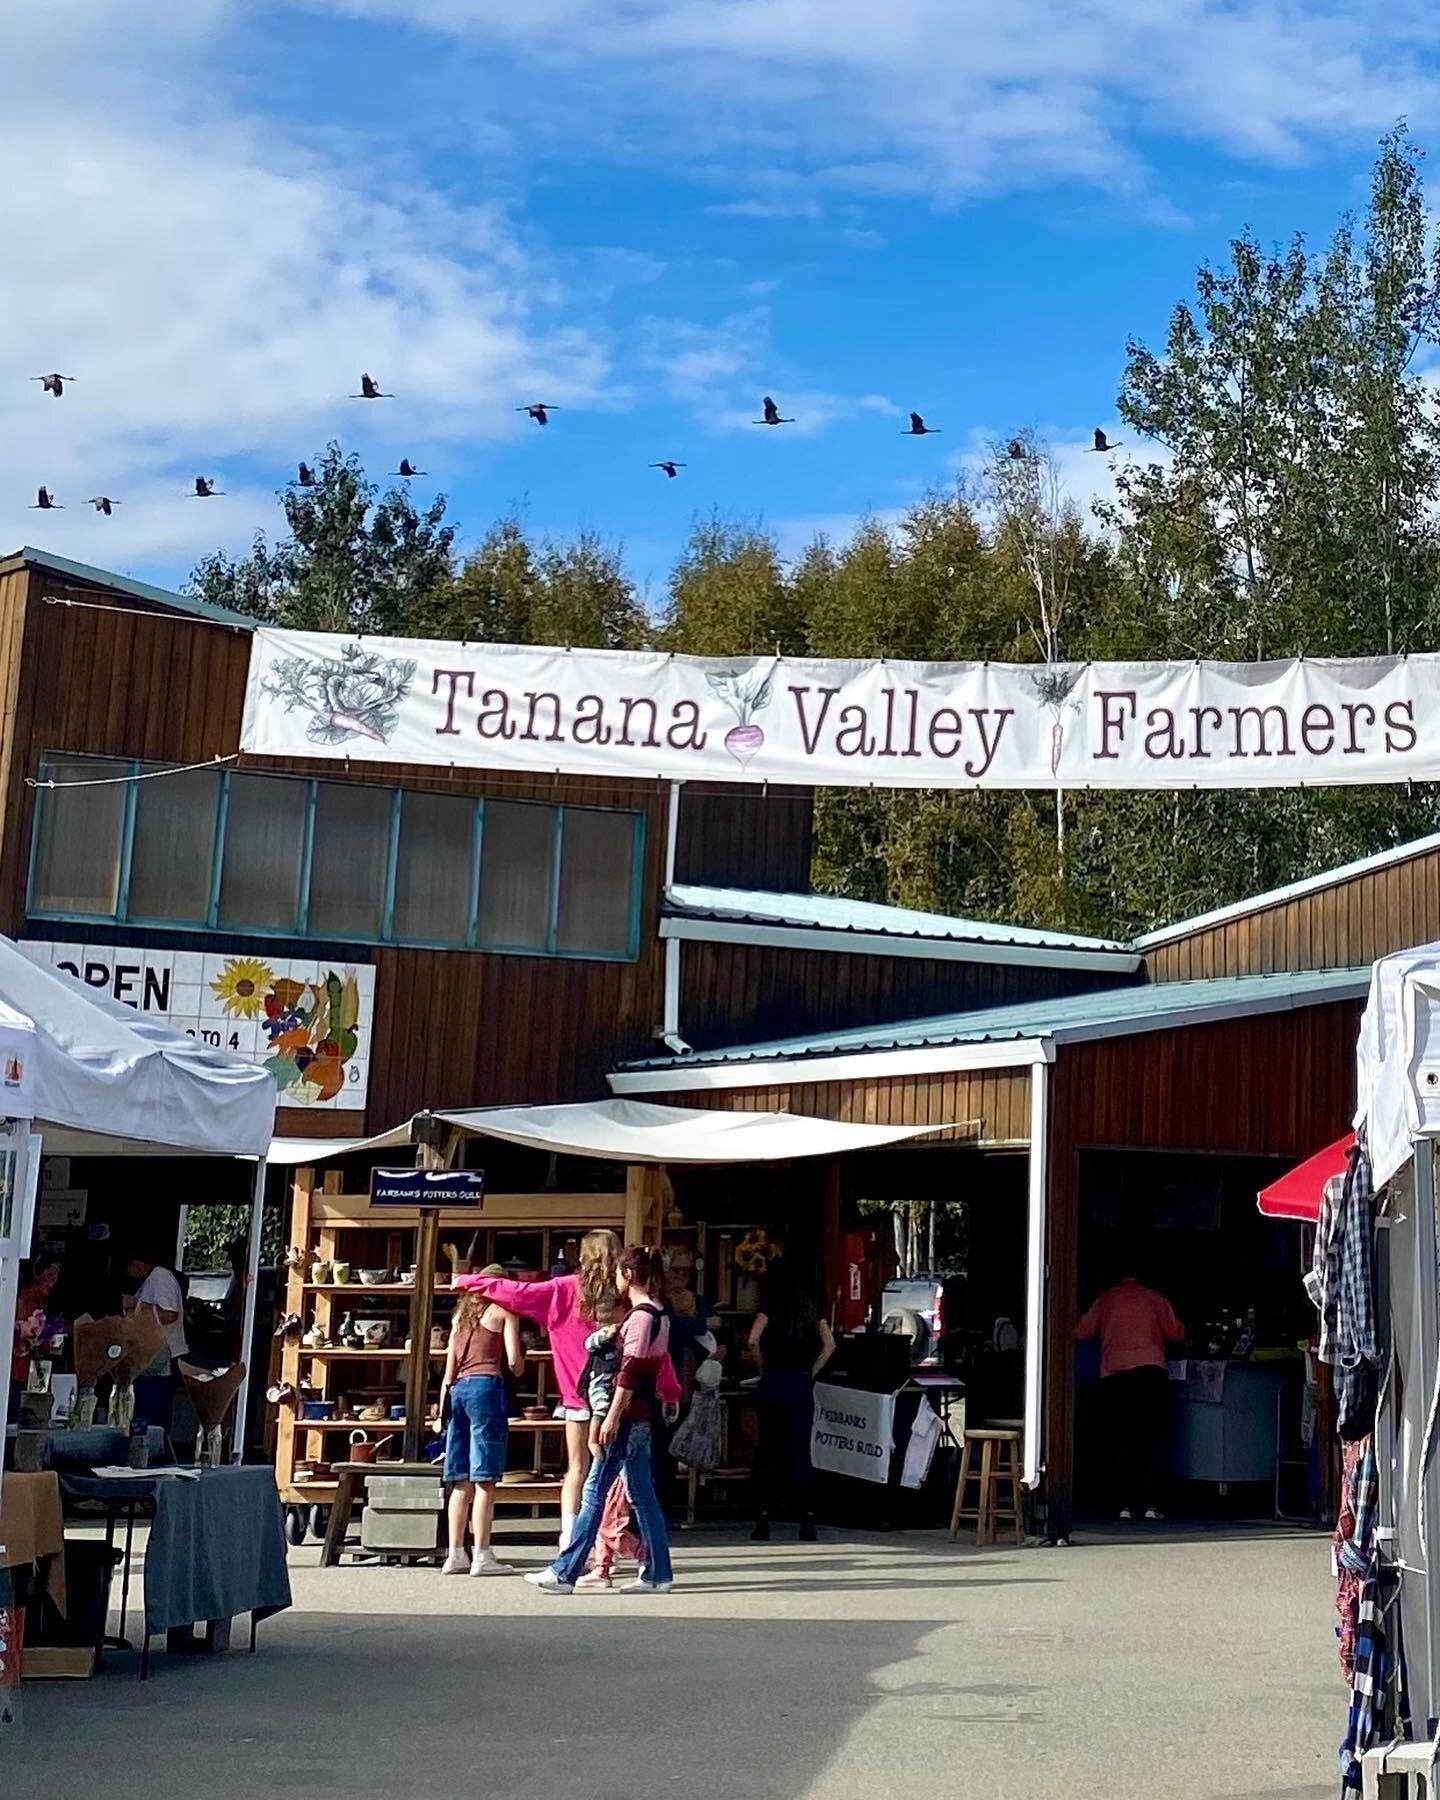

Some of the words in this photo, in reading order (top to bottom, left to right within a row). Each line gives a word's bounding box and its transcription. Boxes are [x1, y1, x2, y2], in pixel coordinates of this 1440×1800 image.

[432, 668, 707, 751] Tanana
[787, 686, 1015, 779] Valley
[1093, 690, 1418, 760] Farmers
[228, 1031, 240, 1050] 4
[376, 1188, 420, 1199] FAIRBANKS
[422, 1190, 457, 1199] POTTERS
[820, 1407, 867, 1430] FAIRBANKS
[815, 1431, 855, 1452] POTTERS
